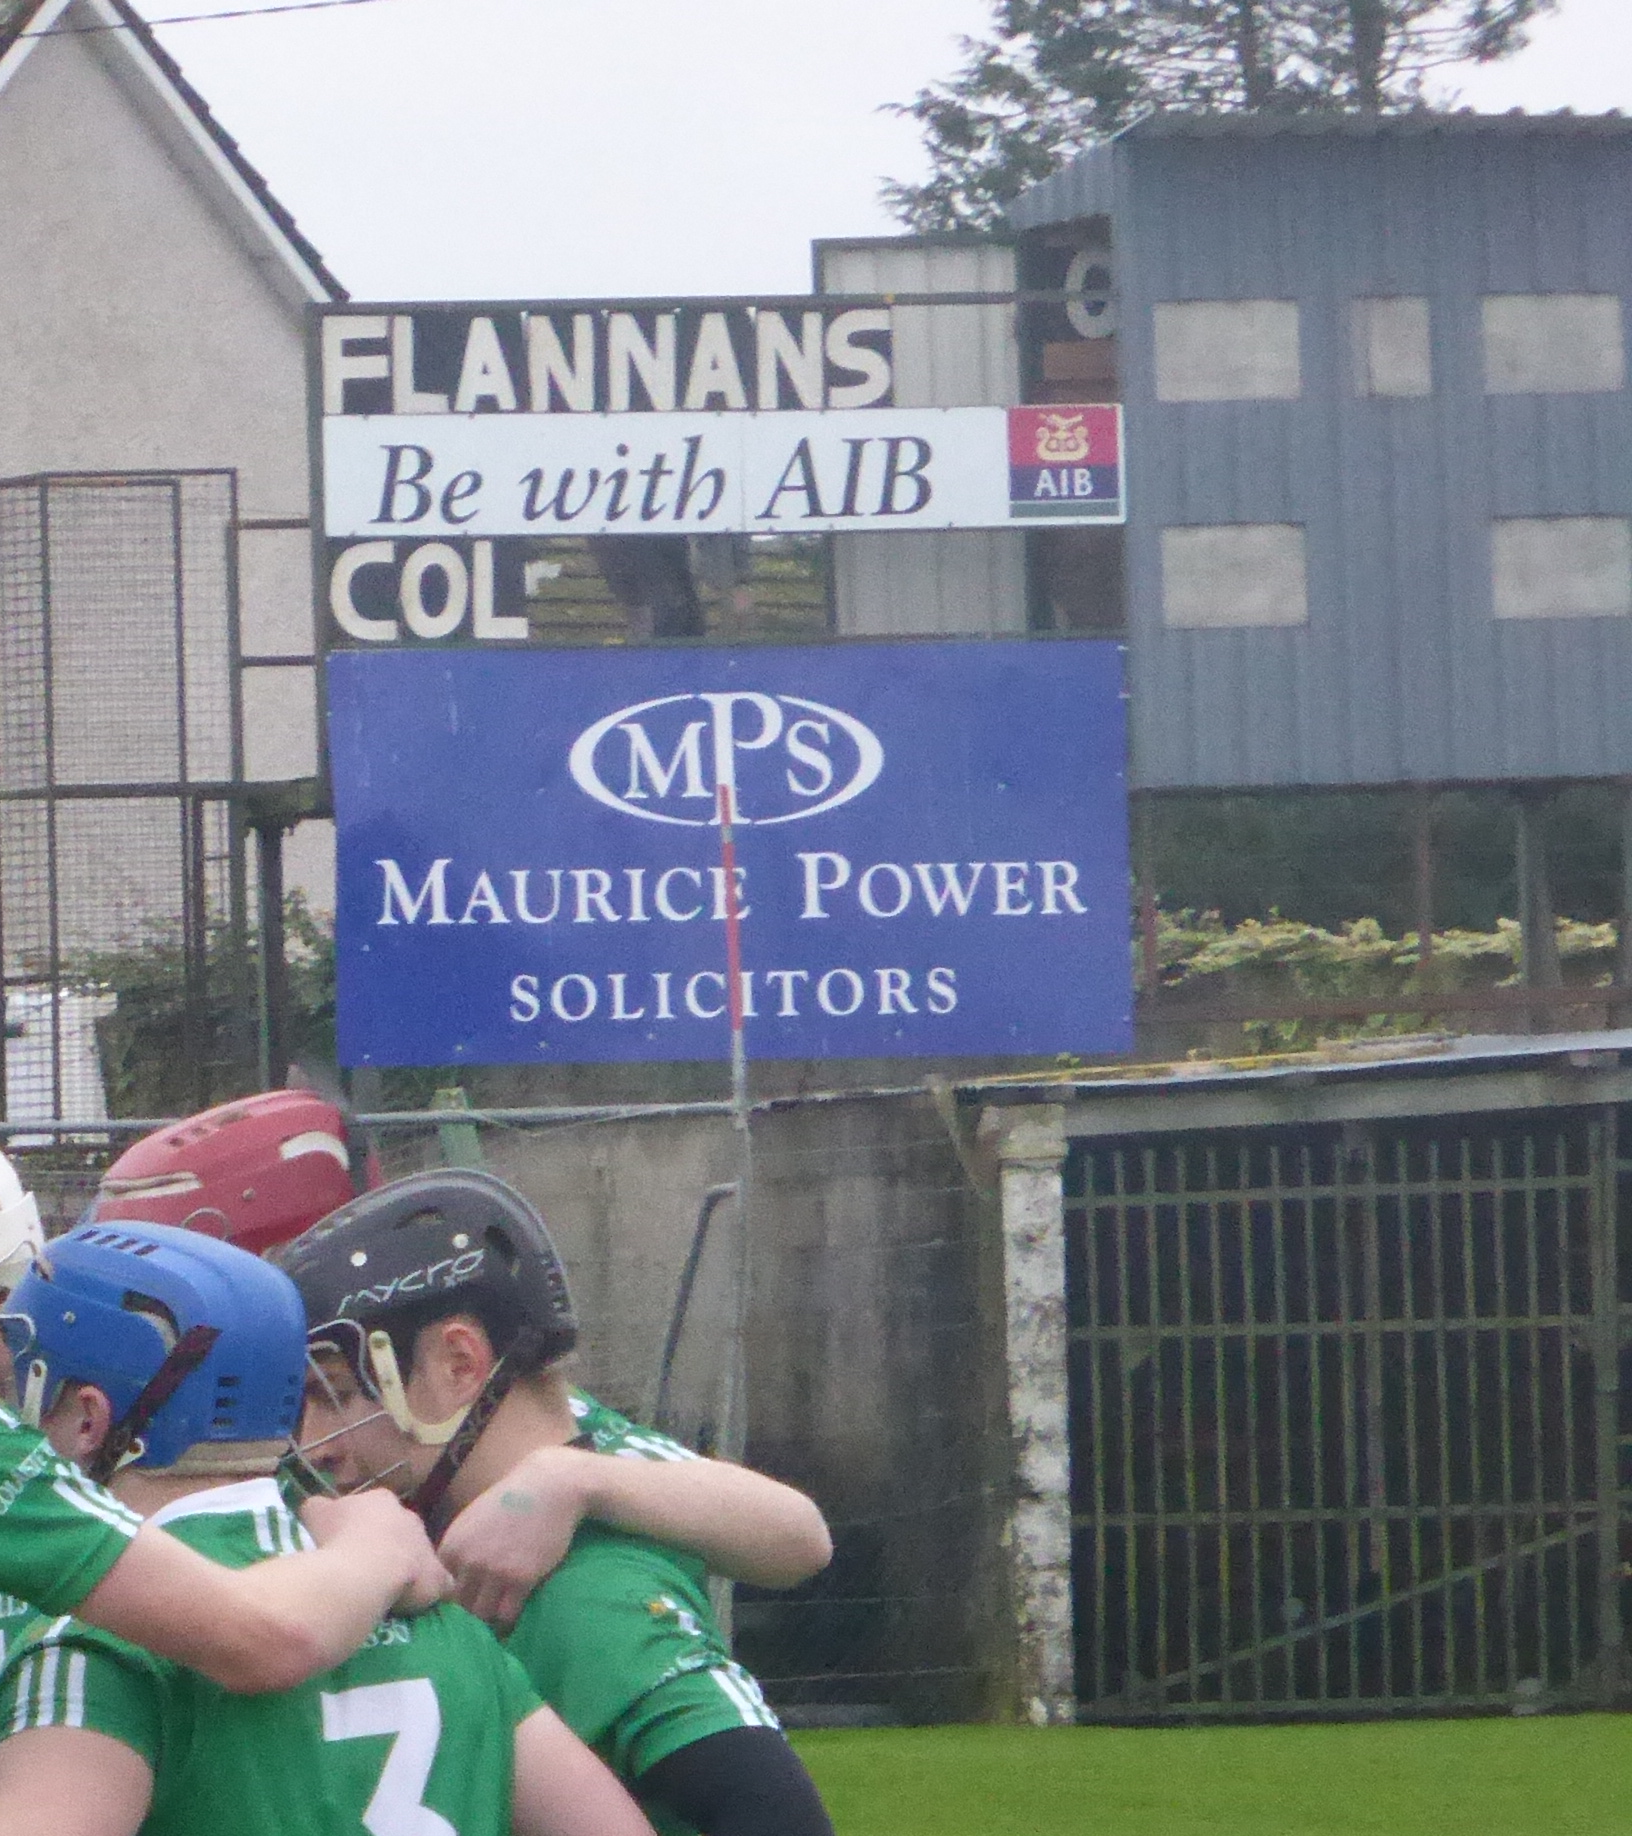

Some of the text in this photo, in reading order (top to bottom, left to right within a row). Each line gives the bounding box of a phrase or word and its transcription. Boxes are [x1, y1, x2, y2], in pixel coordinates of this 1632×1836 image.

[322, 308, 896, 414] FLANNANS
[370, 436, 935, 524] Be with AIB
[1034, 468, 1094, 500] AIB
[330, 539, 530, 641] COL
[623, 692, 835, 826] MPS
[376, 851, 1088, 925] MAURICE POWER
[511, 966, 959, 1022] SOLICITORS
